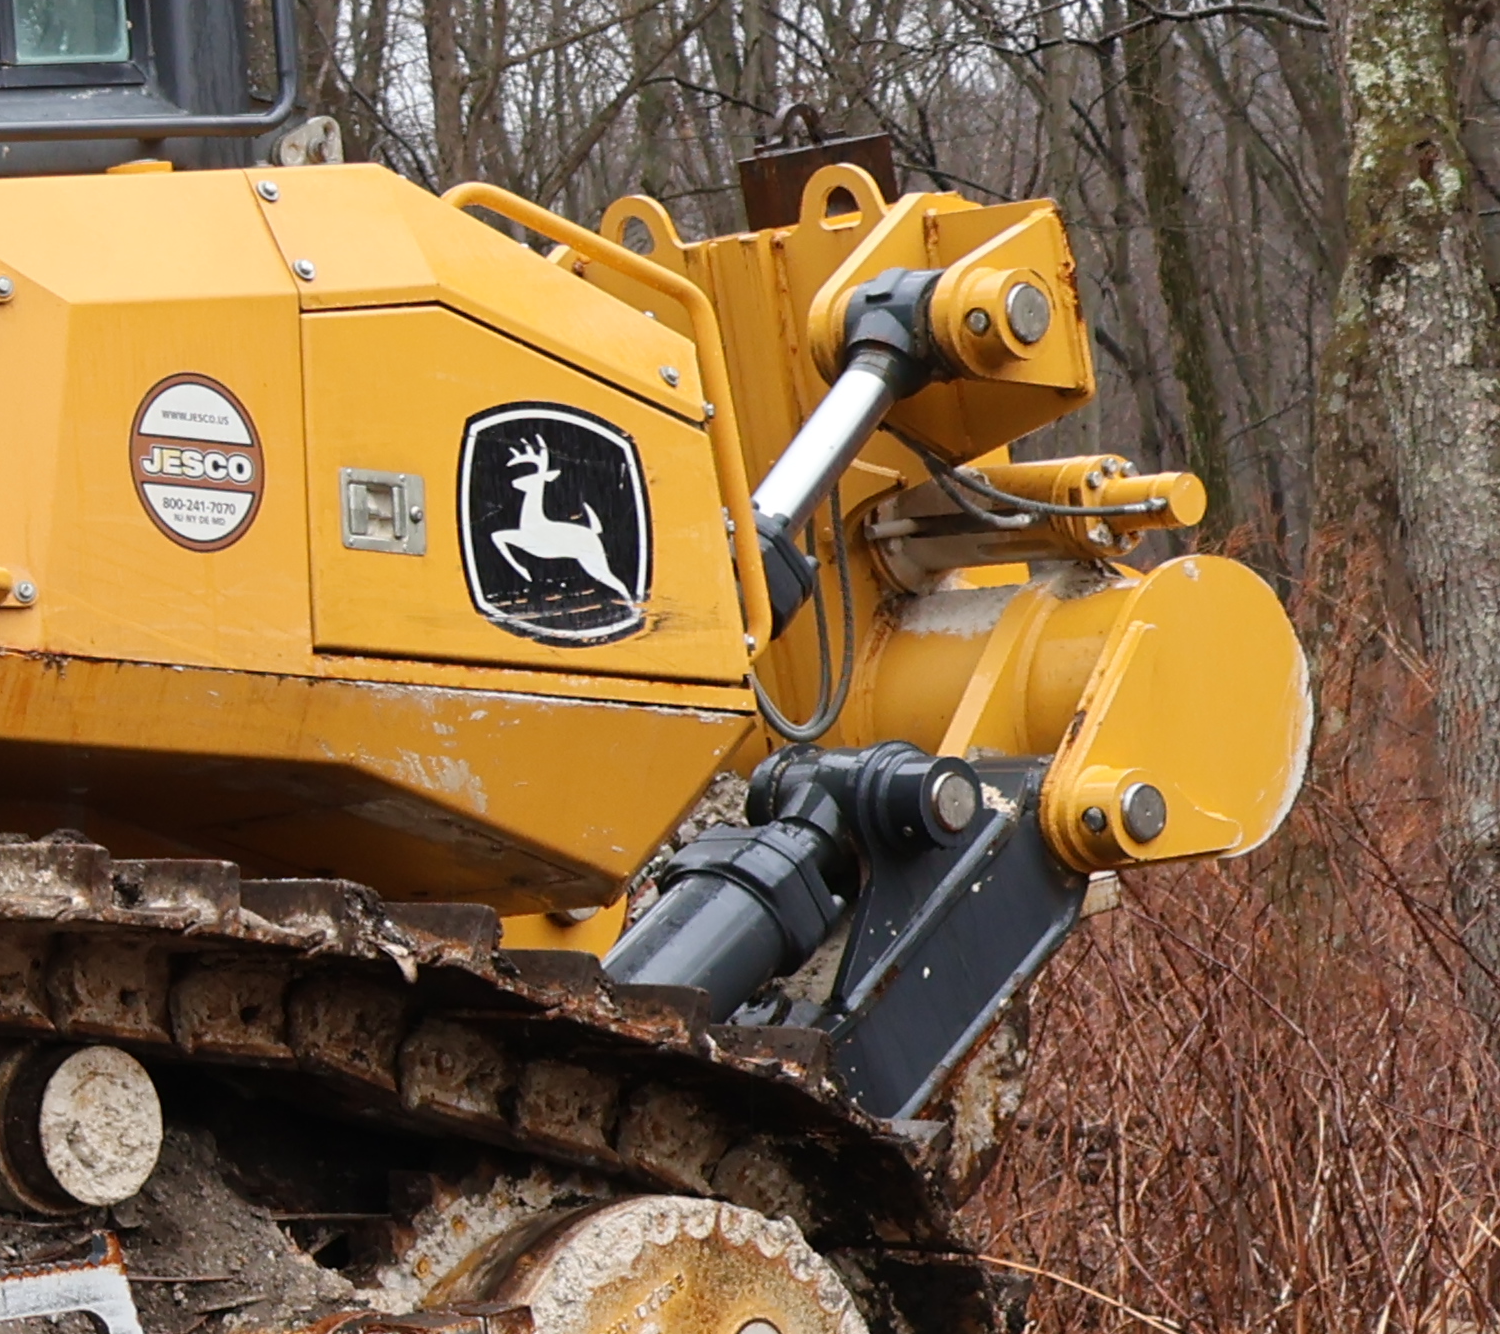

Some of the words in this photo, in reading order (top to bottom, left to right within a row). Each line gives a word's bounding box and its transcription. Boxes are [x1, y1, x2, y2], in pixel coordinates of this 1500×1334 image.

[161, 410, 229, 426] WWW.JESCO.US
[142, 445, 254, 484] JESCO
[162, 497, 236, 515] 800-241-7070
